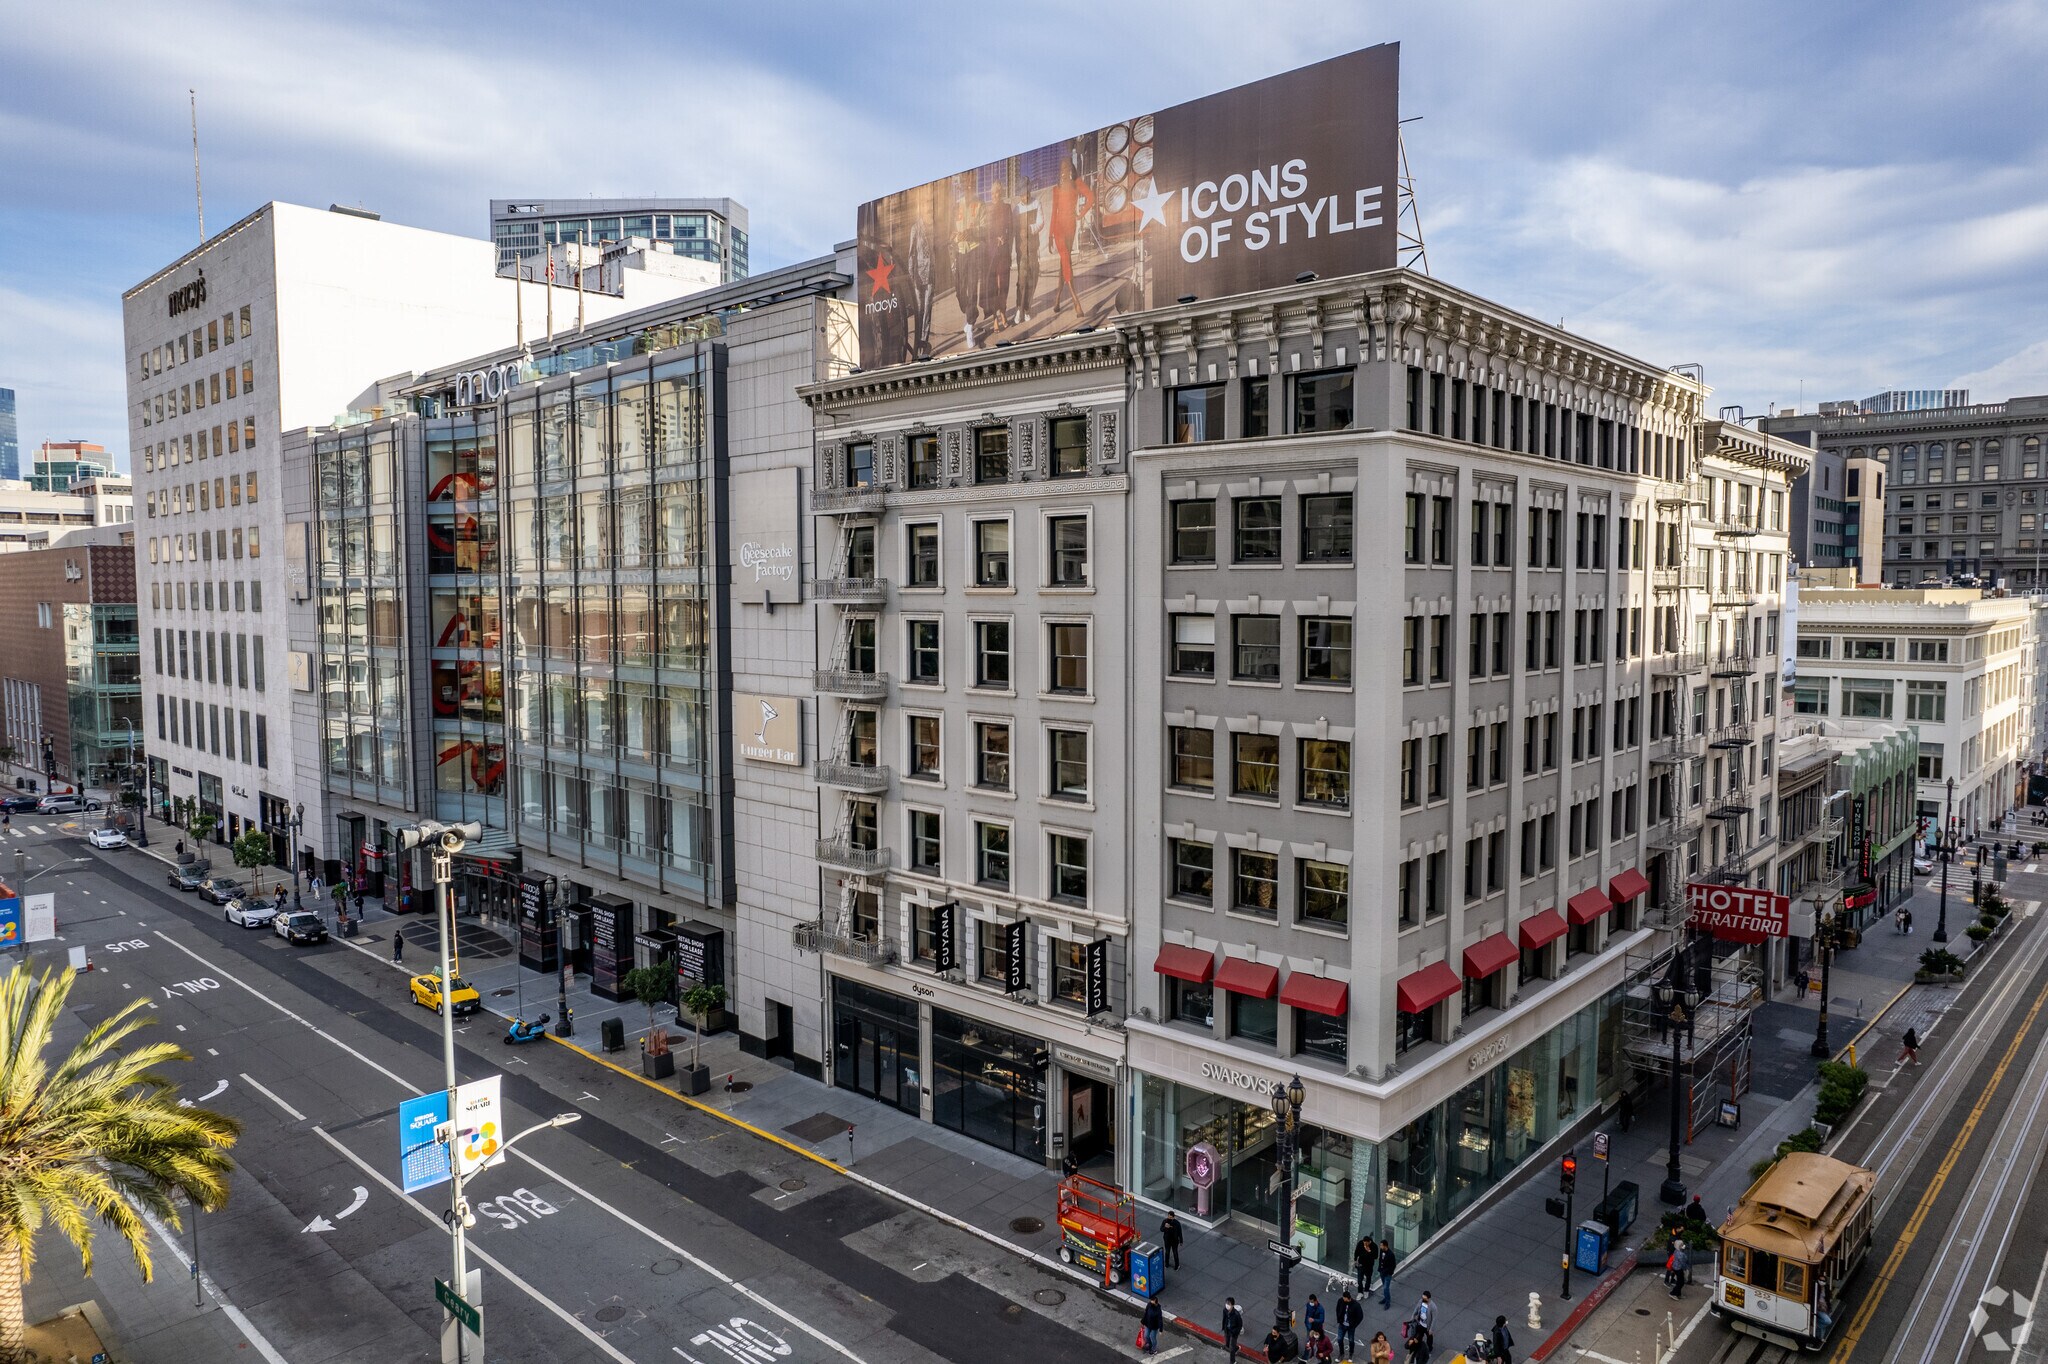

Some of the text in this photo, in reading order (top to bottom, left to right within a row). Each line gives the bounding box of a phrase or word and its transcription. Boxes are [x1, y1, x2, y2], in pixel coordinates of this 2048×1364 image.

[1181, 158, 1309, 223] ICONS
[1180, 185, 1383, 264] OF STYLE
[168, 267, 207, 318] macy's
[865, 293, 898, 315] macy's
[740, 541, 793, 568] Cheesecake
[750, 558, 794, 584] Factory
[740, 743, 796, 762] Burger Bar
[1853, 803, 1862, 847] WINE SHOP
[1691, 886, 1784, 919] HOTEL
[1689, 909, 1783, 935] STRATFORD
[104, 939, 150, 954] BUS
[635, 936, 661, 950] RETAIL SHOP
[677, 934, 705, 949] RETAIL SHOPS
[679, 942, 703, 956] FOR LEASE
[941, 909, 950, 966] CUYANA
[1012, 926, 1020, 986] CUYANA
[161, 977, 220, 999] ONLY
[912, 982, 935, 998] dyson
[1201, 1062, 1277, 1096] SWAROVSK
[409, 1115, 438, 1130] SQUARE
[413, 1111, 435, 1123] UNION
[477, 1187, 560, 1230] BUS
[1270, 1243, 1291, 1255] ONE WAY
[444, 1291, 470, 1324] Geary
